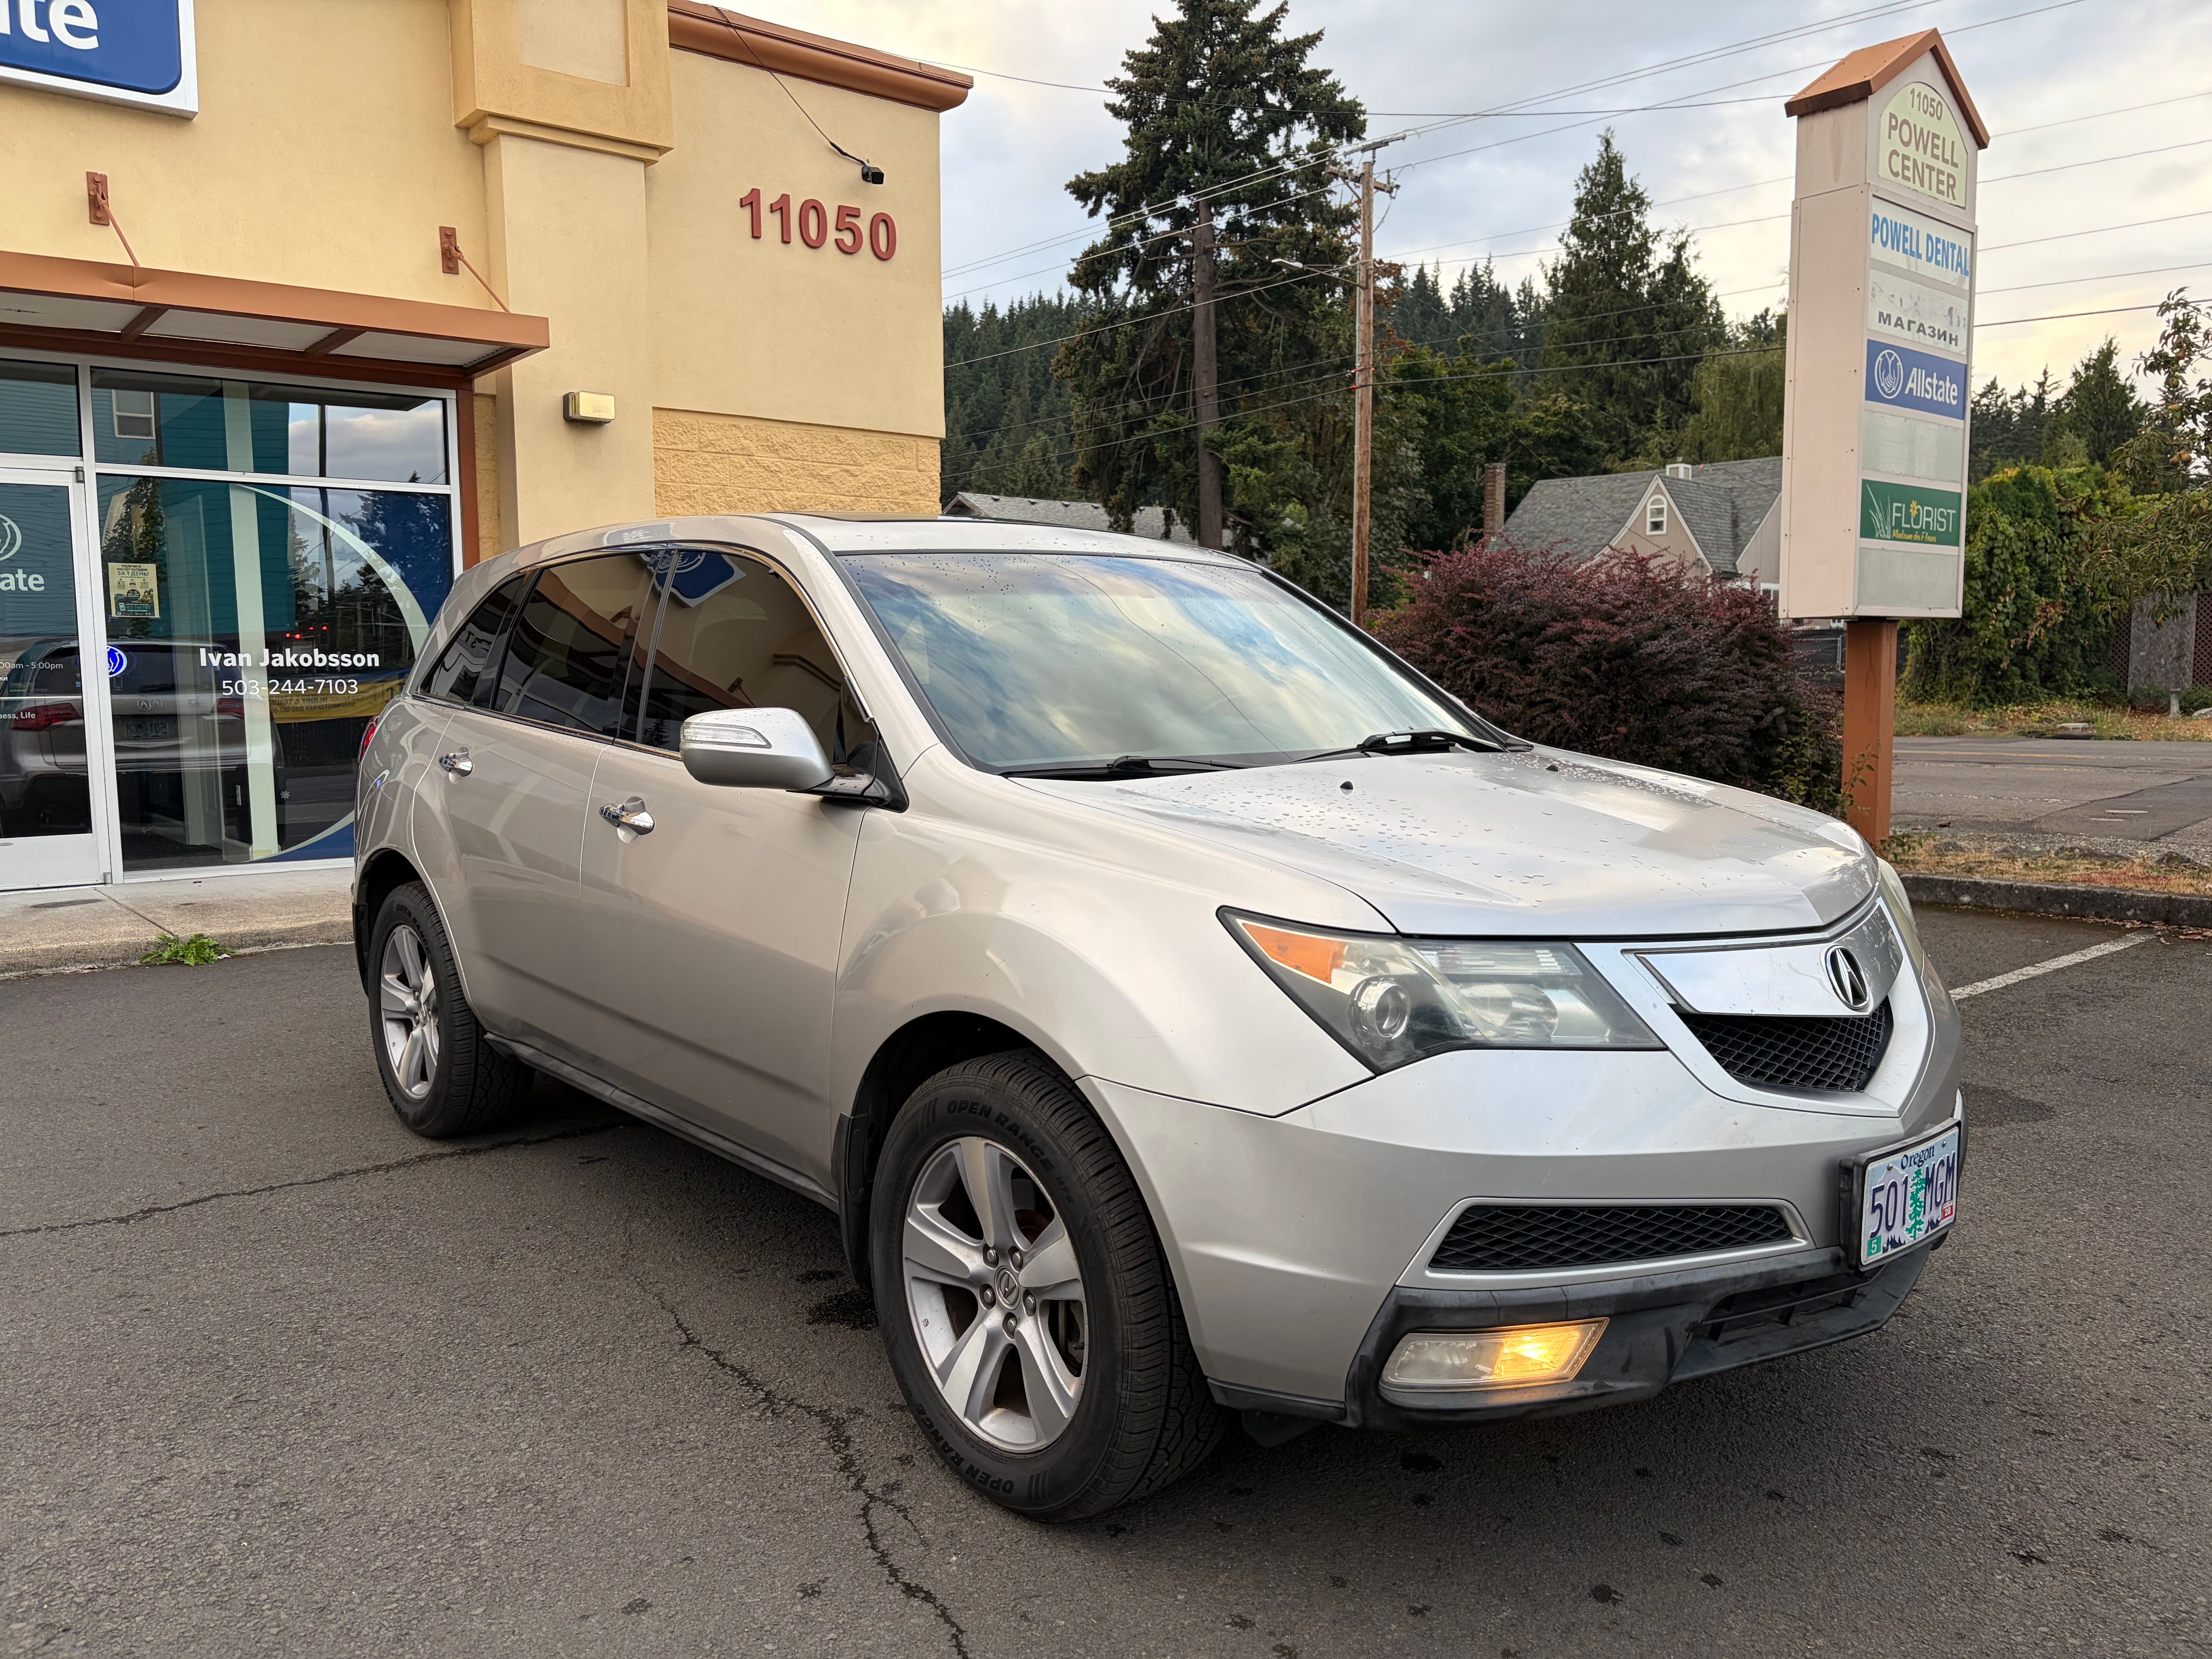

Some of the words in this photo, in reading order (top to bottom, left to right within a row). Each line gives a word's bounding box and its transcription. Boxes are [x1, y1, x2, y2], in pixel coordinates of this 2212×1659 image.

[1910, 88, 1943, 121] 11050
[1888, 112, 1958, 168] POWELL
[1888, 149, 1956, 201] CENTER
[740, 188, 896, 261] 11050
[1872, 213, 1922, 259] POWELL
[1926, 233, 1969, 276] DENTAL
[1878, 311, 1958, 347] МАГАЗИН
[1905, 367, 1958, 405] Allstate
[1892, 502, 1956, 532] FLORIST
[31, 662, 63, 670] 5:00pm
[200, 648, 252, 666] Ivan
[259, 648, 379, 667] Jakobsson
[222, 679, 358, 696] 503-244-7103
[947, 1099, 993, 1119] OPEN
[994, 1112, 1054, 1172] RANGE
[1901, 1145, 1935, 1170] Oregon
[1870, 1174, 1908, 1238] 501
[1923, 1151, 1956, 1216] MGM
[1944, 1207, 1951, 1217] 28
[1871, 1239, 1877, 1254] 5
[914, 1403, 965, 1467] RANGE
[965, 1464, 1015, 1494] OPEN
